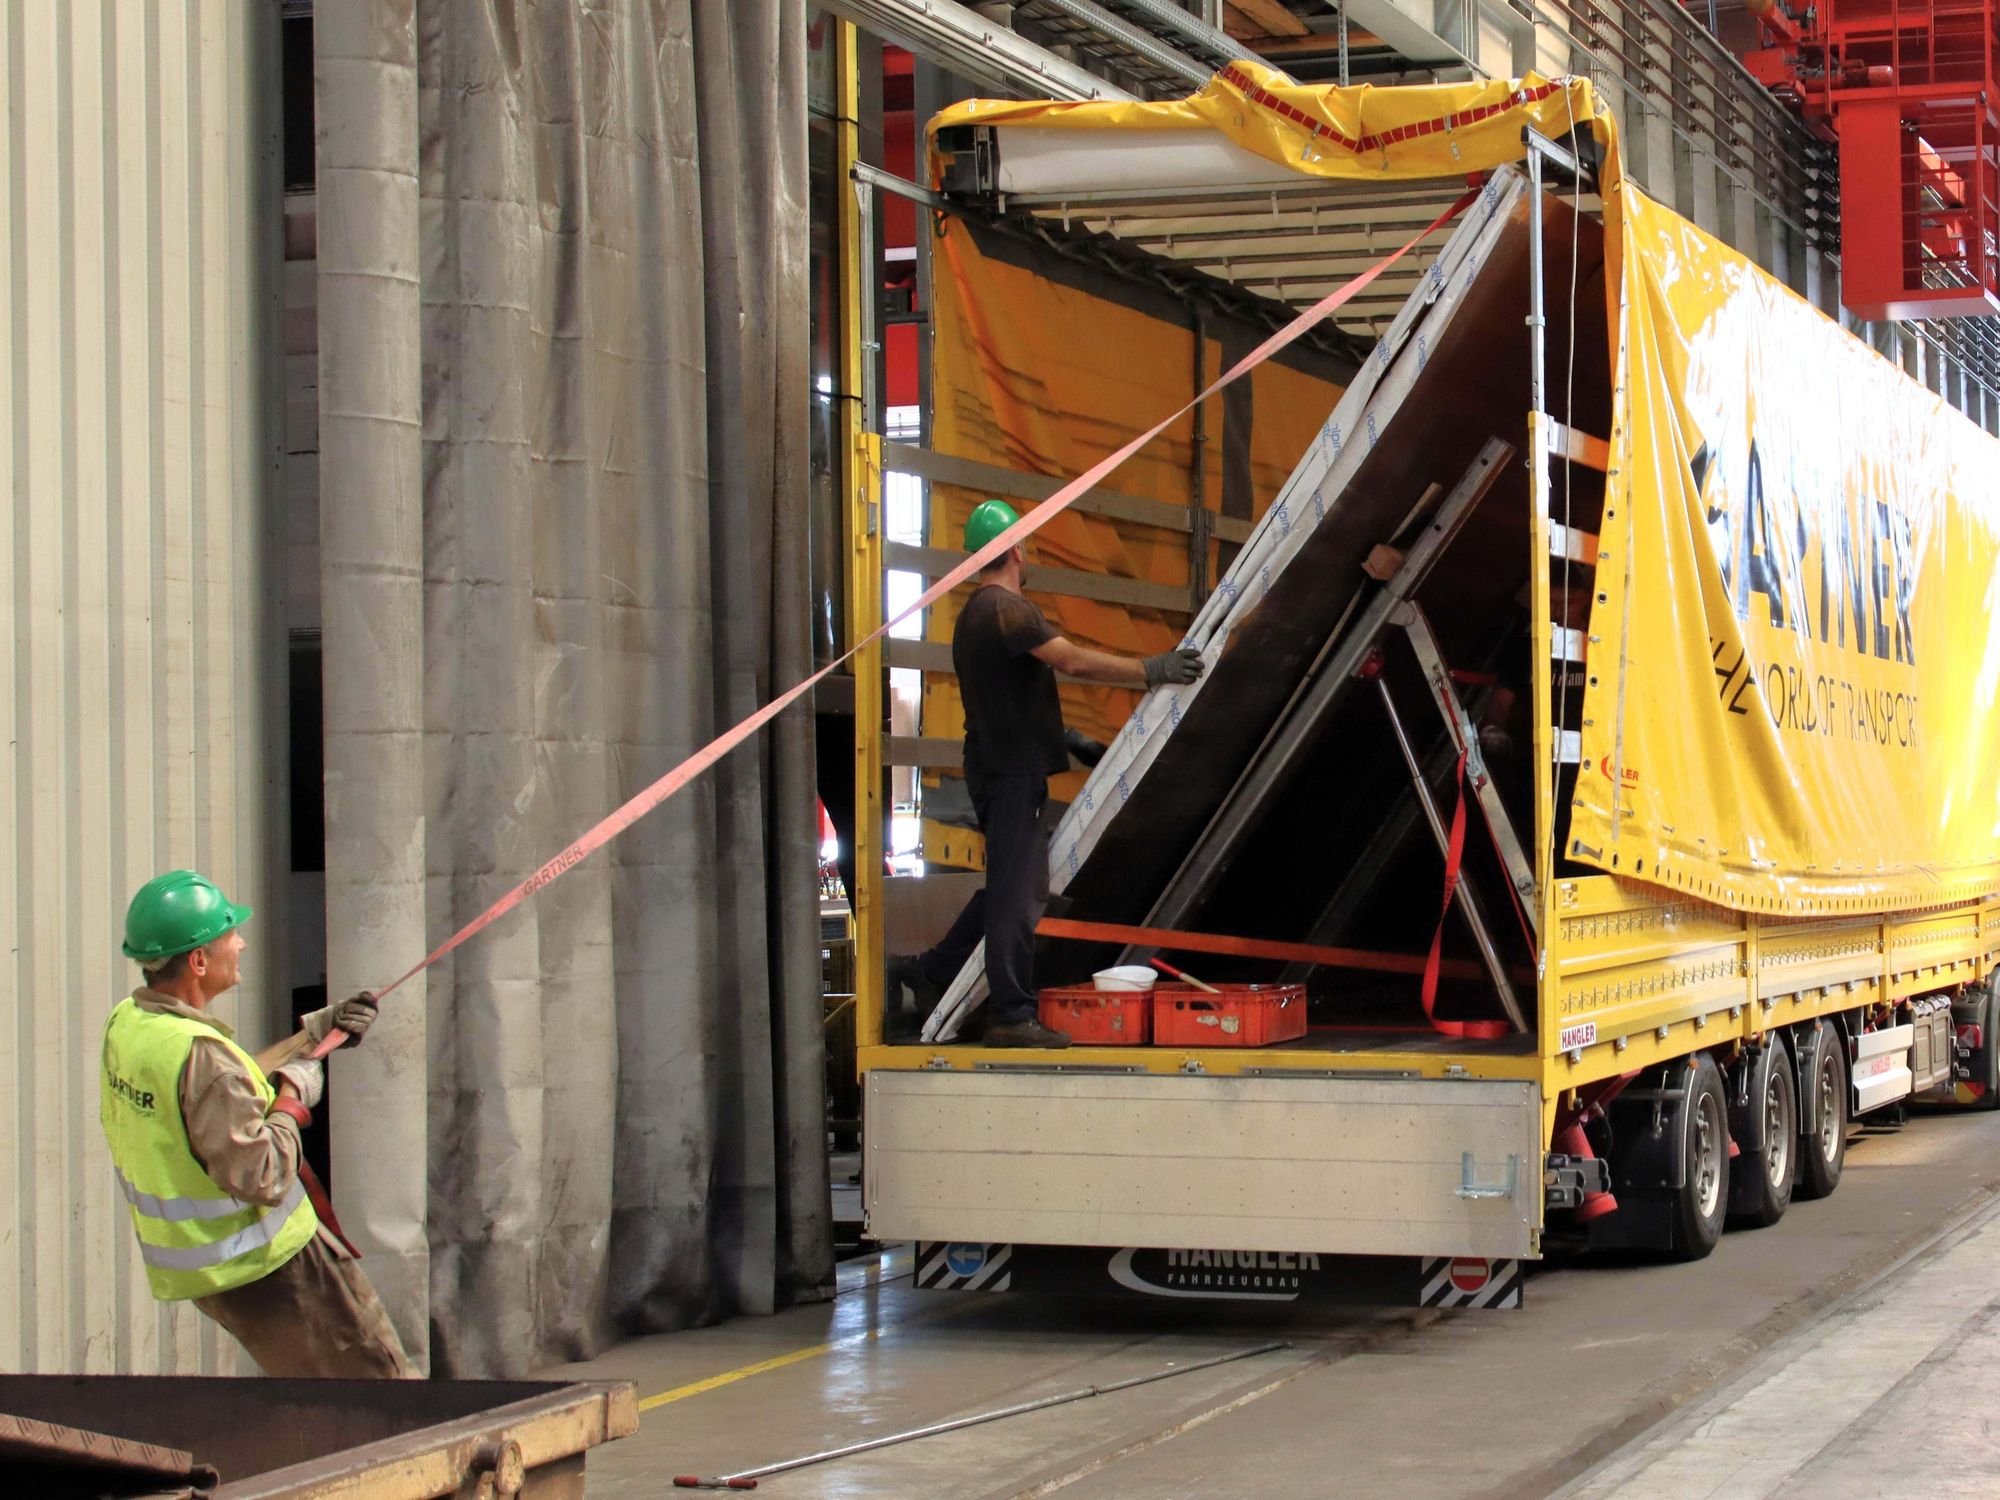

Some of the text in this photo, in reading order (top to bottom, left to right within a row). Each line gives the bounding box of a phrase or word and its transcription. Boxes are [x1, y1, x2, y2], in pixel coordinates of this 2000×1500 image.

[1709, 637, 1758, 716] HE
[1817, 673, 1836, 737] OF
[523, 845, 584, 895] GARTNER
[1562, 1024, 1595, 1049] HANGLER
[1168, 1273, 1299, 1288] FAHRZEUGBAU
